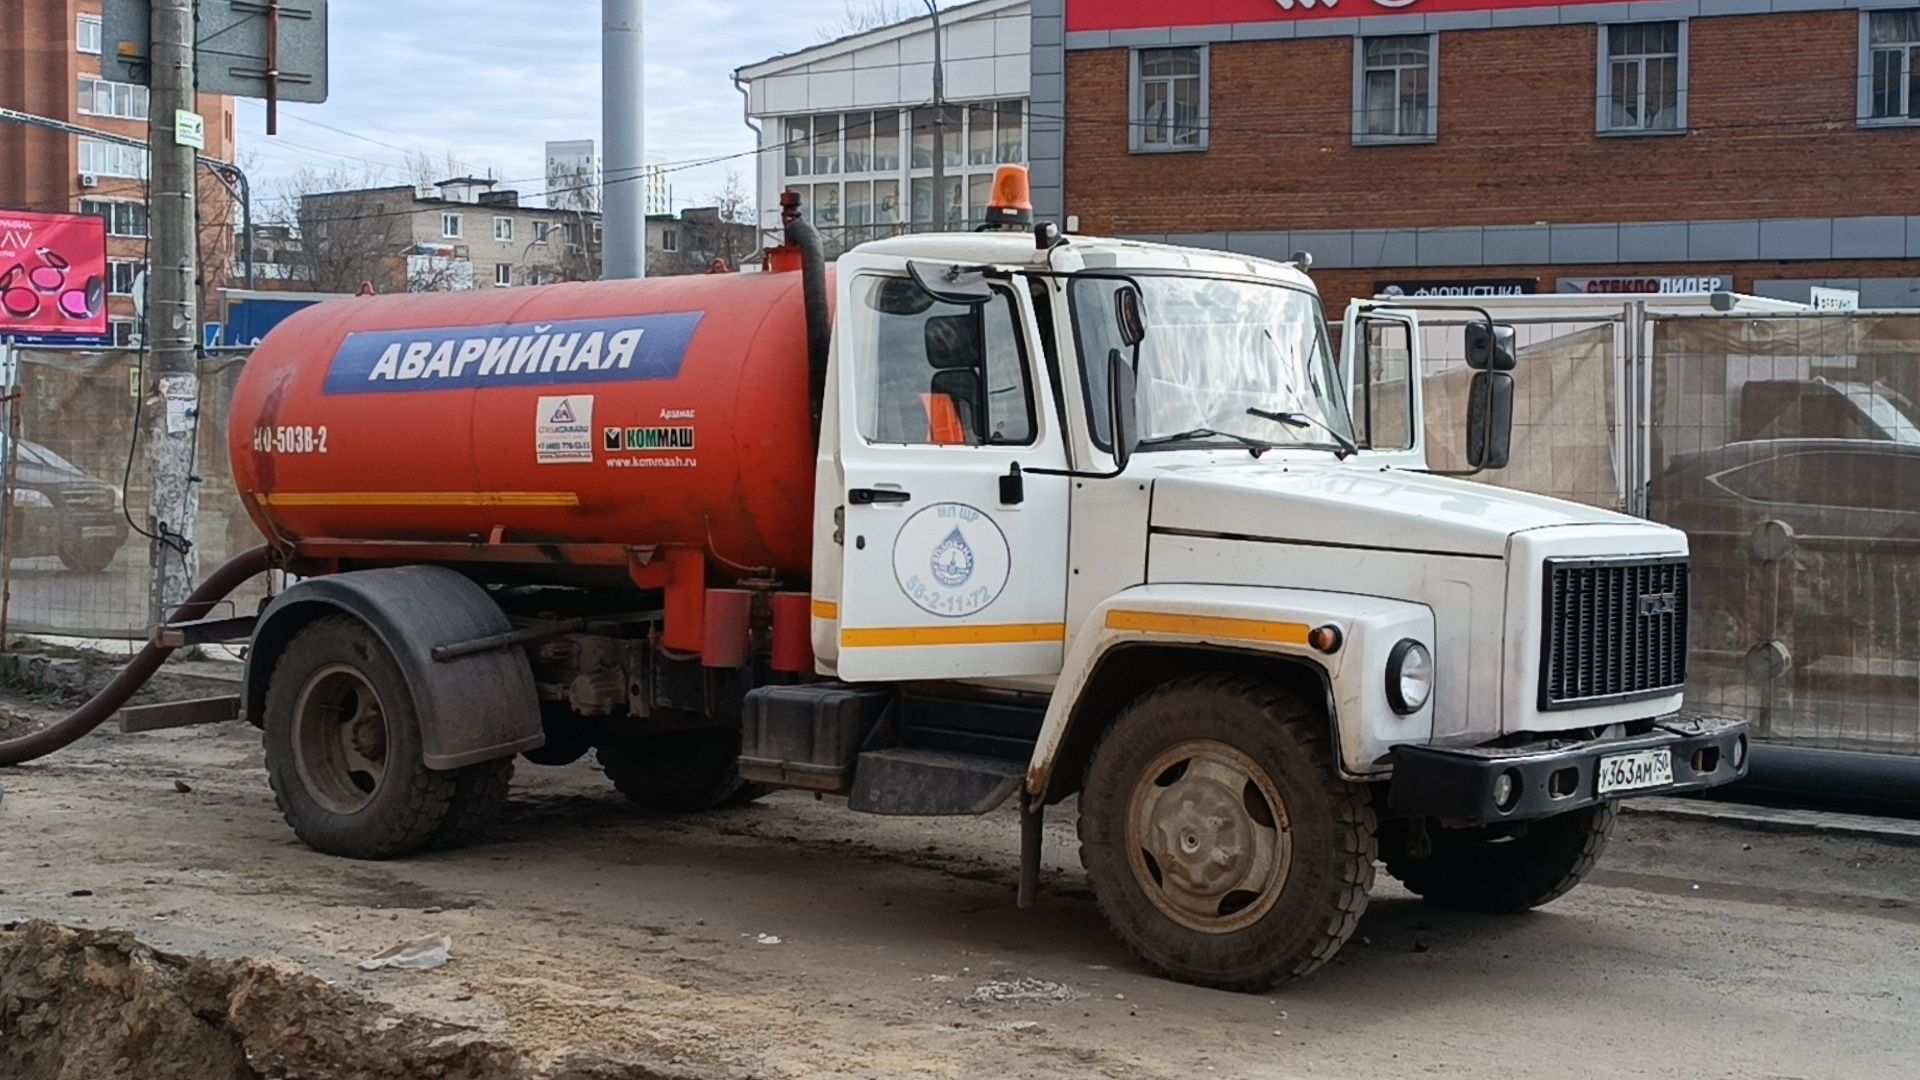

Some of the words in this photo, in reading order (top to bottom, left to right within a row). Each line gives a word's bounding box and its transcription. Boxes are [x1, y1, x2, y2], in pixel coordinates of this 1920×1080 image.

[368, 324, 644, 381] АВАРИЙНАЯ
[627, 428, 694, 448] КОММАШ
[606, 455, 697, 468] www.kommash.ru
